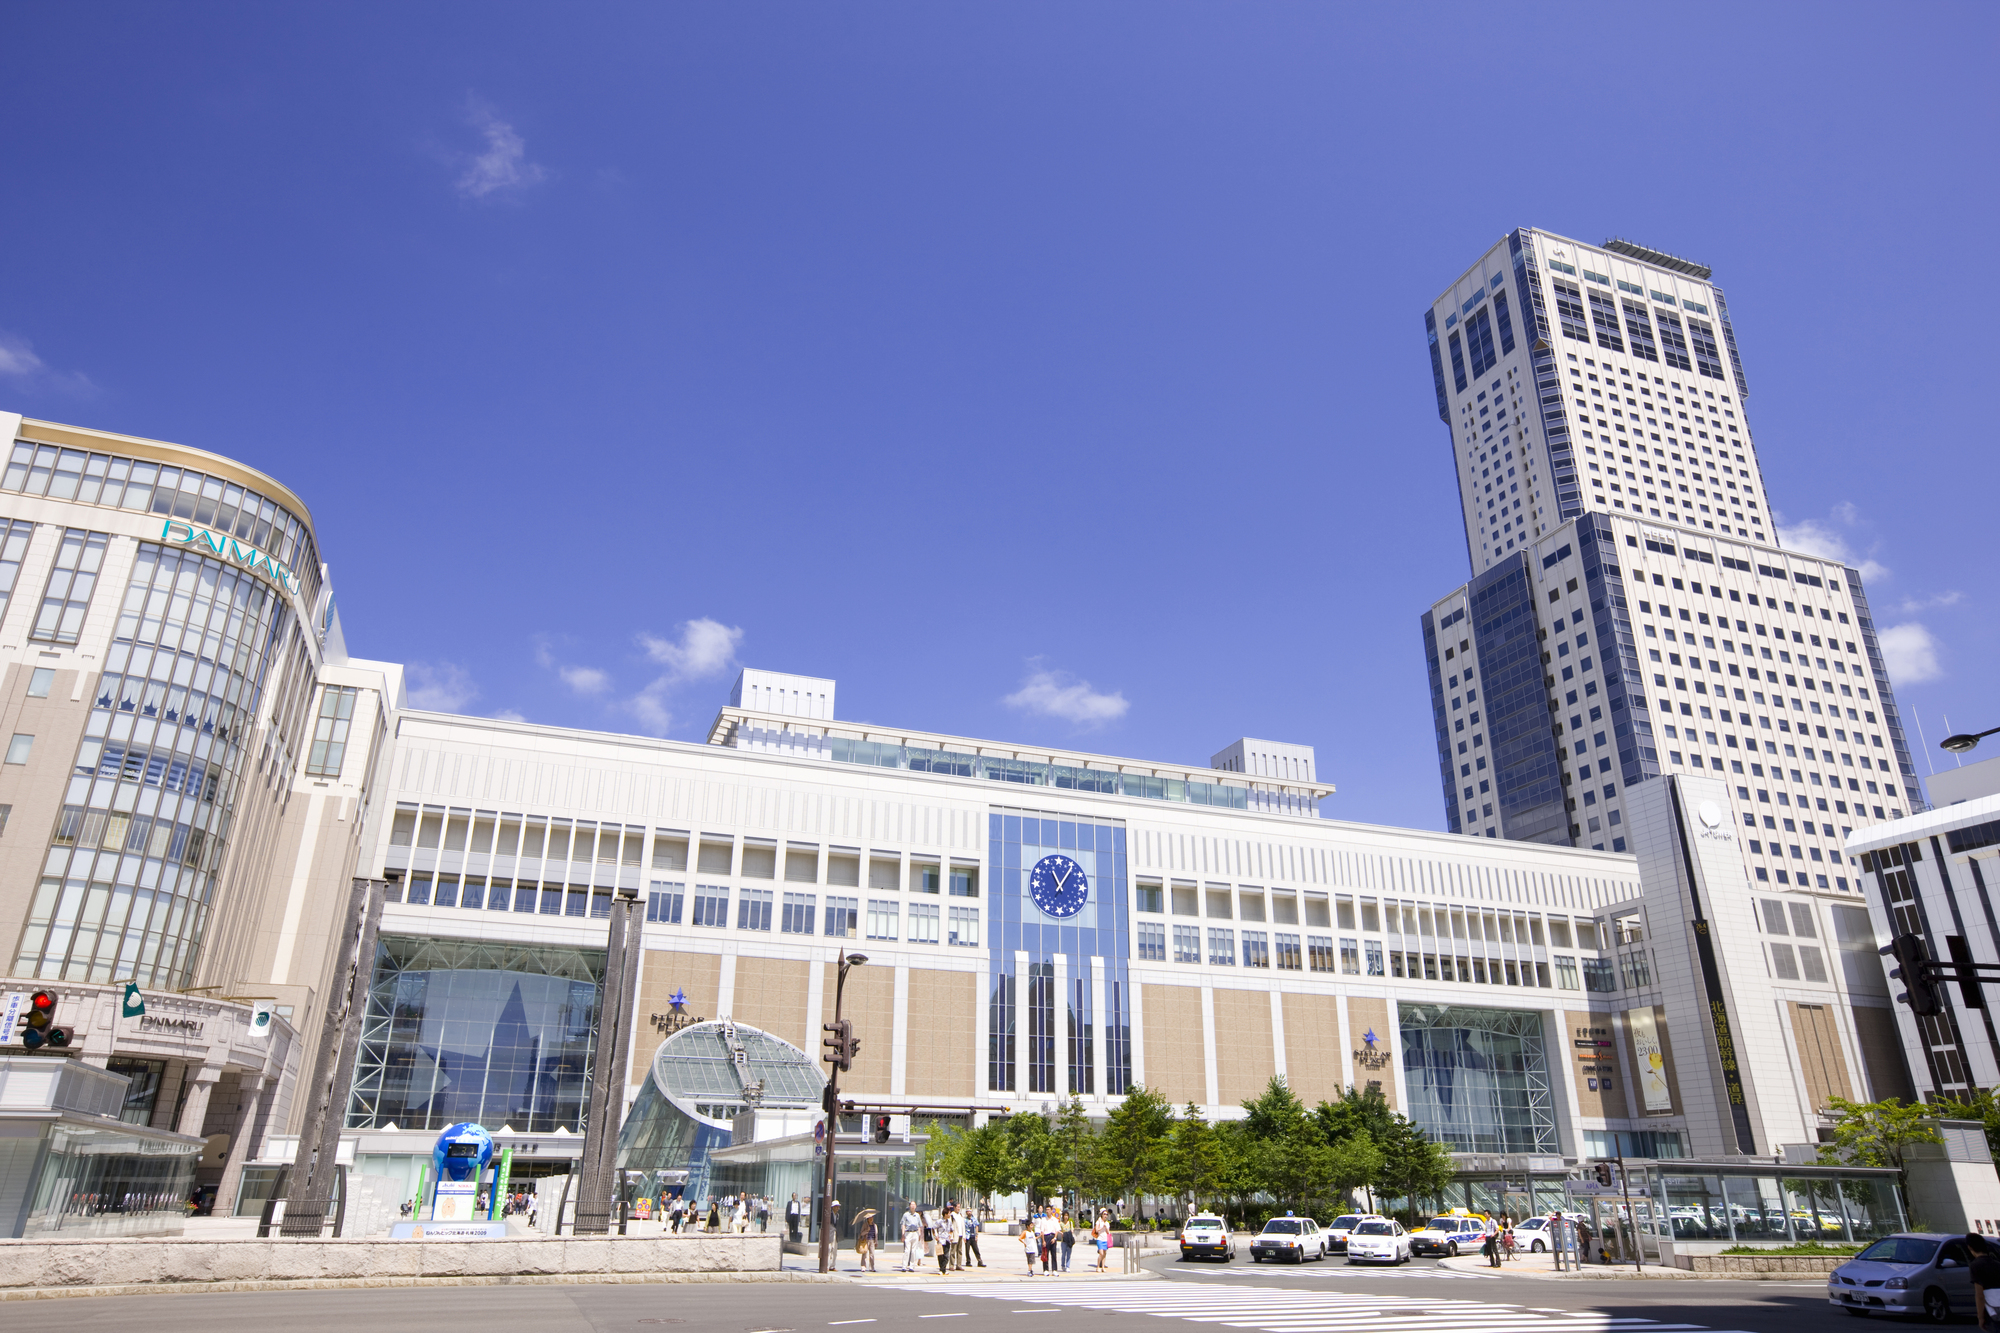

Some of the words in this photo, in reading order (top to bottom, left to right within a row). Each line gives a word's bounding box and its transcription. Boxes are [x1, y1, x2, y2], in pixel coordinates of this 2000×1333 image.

[161, 520, 301, 596] DAIMARU
[139, 1016, 204, 1031] DAIMARU
[1353, 1049, 1391, 1057] STELLAR
